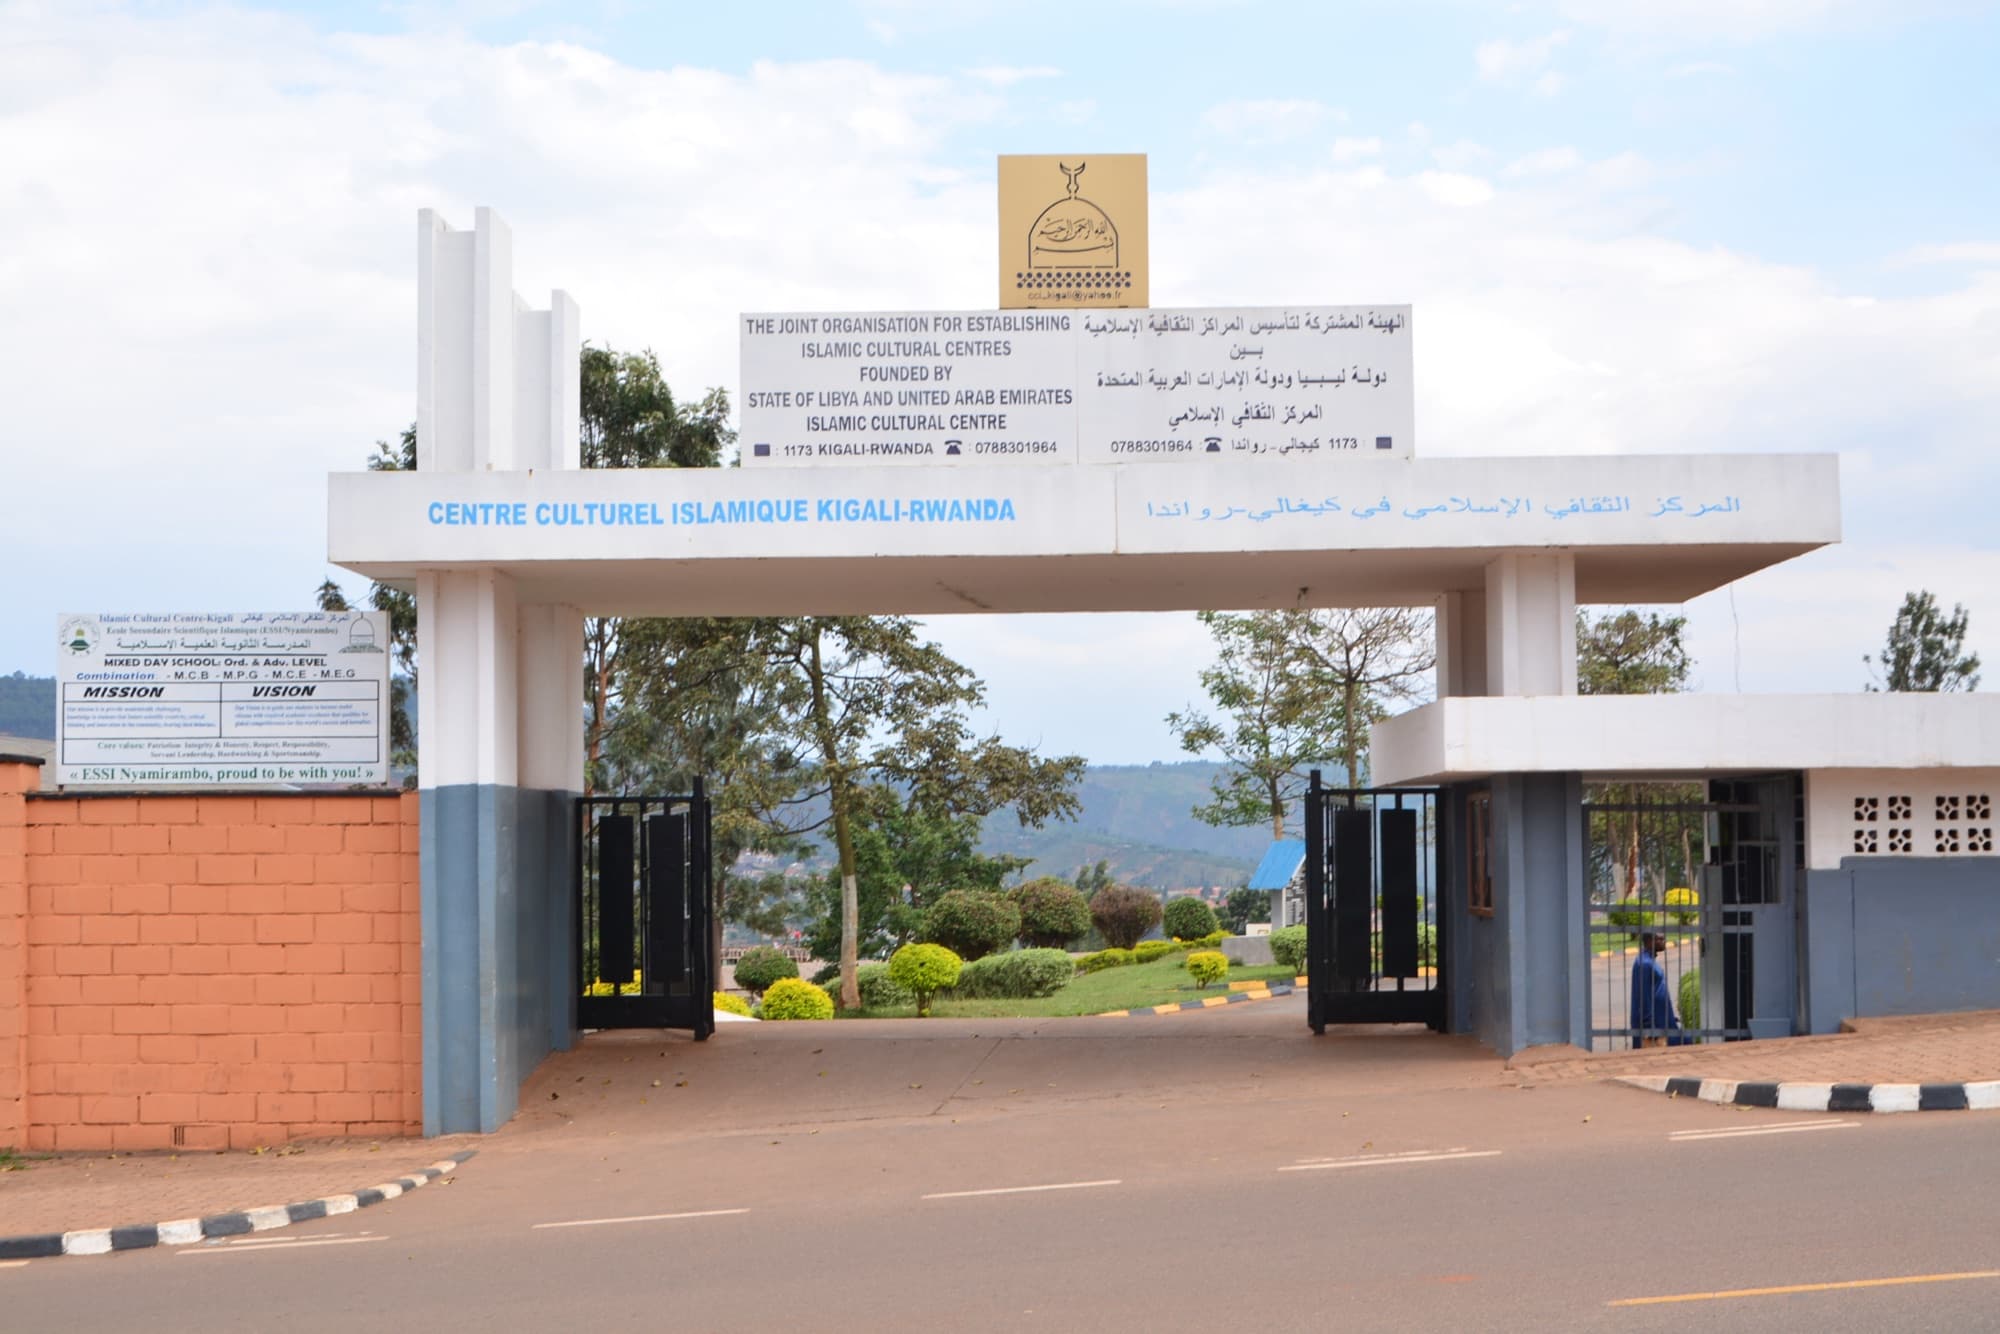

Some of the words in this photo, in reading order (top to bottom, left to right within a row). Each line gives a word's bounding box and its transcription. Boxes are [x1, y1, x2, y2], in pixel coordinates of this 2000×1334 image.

[746, 318, 775, 334] THE
[778, 318, 818, 334] JOINT
[822, 317, 929, 334] ORGANISATION
[933, 317, 962, 332] FOR
[967, 315, 1071, 332] ESTABLISHING
[1084, 315, 1143, 340] الإسلامية
[1148, 315, 1194, 337] الثقافية
[1199, 315, 1244, 336] المراكز
[1249, 312, 1300, 336] لتأسيس
[1304, 312, 1364, 331] المشتركة
[1367, 312, 1405, 335] الهيئة
[801, 342, 862, 358] ISLAMIC
[866, 341, 941, 358] CULTURAL
[945, 340, 1012, 357] CENTRES
[1229, 343, 1264, 360] بين
[860, 366, 929, 382] FOUNDED
[934, 365, 953, 381] BY
[1097, 368, 1143, 387] المتحدة
[1148, 369, 1191, 392] العربية
[1197, 369, 1249, 392] الإمارات
[1254, 366, 1293, 388] ودولة
[1297, 369, 1345, 387] ليبيا
[1351, 365, 1387, 387] دولة
[748, 391, 791, 408] STATE
[795, 391, 814, 407] OF
[818, 391, 859, 407] LIBYA
[863, 391, 893, 407] AND
[898, 390, 950, 406] UNITED
[954, 389, 995, 405] ARAB
[1000, 389, 1073, 405] EMIRATES
[806, 415, 866, 432] ISLAMIC
[870, 415, 946, 431] CULTURAL
[950, 414, 1007, 430] CENTRE
[1168, 405, 1225, 432] الإسلامي
[1231, 400, 1275, 428] الثقافي
[1279, 404, 1322, 425] المركز
[784, 445, 813, 456] 1173
[818, 442, 934, 456] KIGALI-RWANDA
[975, 441, 1058, 454] 0788301964
[1111, 439, 1193, 453] 0788301964
[1328, 437, 1358, 450] 1173
[428, 502, 528, 525] CENTRE
[535, 501, 664, 525] CULTUREL
[672, 500, 808, 524] ISLAMIQUE
[817, 498, 1016, 522] KIGALI-RWANDA
[1351, 495, 1391, 520] في
[1402, 497, 1531, 520] الإسلامي
[1543, 496, 1630, 520] الثقافي
[1648, 496, 1740, 517] المركز
[100, 613, 130, 623] Islamic
[133, 613, 170, 623] Cultural
[174, 613, 234, 624] Centre-Kigali
[104, 658, 141, 667] MIXED
[144, 658, 169, 667] DAY
[224, 658, 248, 667] Ord.
[251, 658, 260, 667] &
[263, 658, 289, 667] Adv.
[292, 658, 327, 667] LEVEL
[83, 686, 165, 698] MISSION
[252, 685, 316, 697] VISION
[82, 767, 115, 780] ESSI
[120, 767, 213, 783] Nyamirambo,
[217, 766, 258, 781] proud
[262, 768, 276, 779] to
[279, 766, 295, 779] be
[300, 765, 328, 779] with
[332, 765, 361, 781] you!
